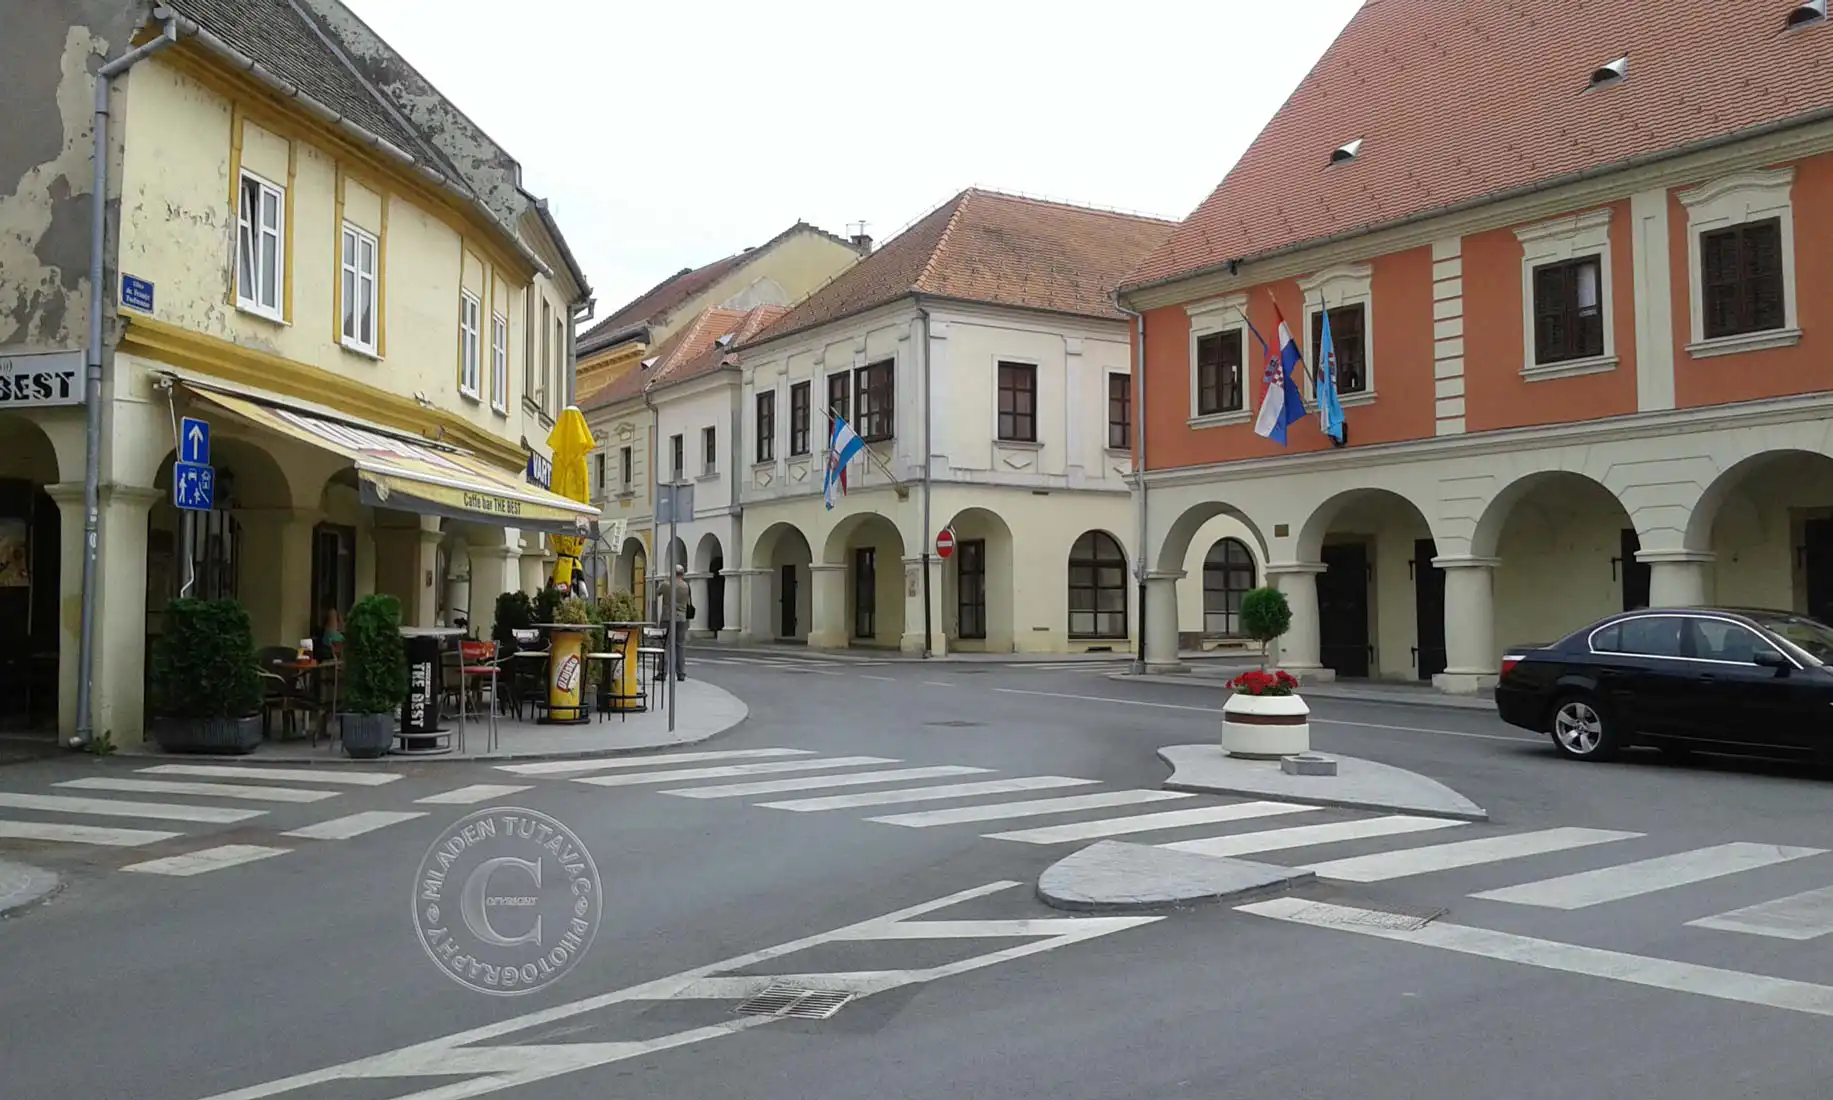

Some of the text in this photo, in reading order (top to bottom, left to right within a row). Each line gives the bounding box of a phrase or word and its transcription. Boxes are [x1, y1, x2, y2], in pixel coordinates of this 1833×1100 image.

[0, 371, 75, 401] BEST
[493, 497, 506, 513] THE
[507, 499, 521, 516] BEST
[410, 662, 426, 728] THE BEST
